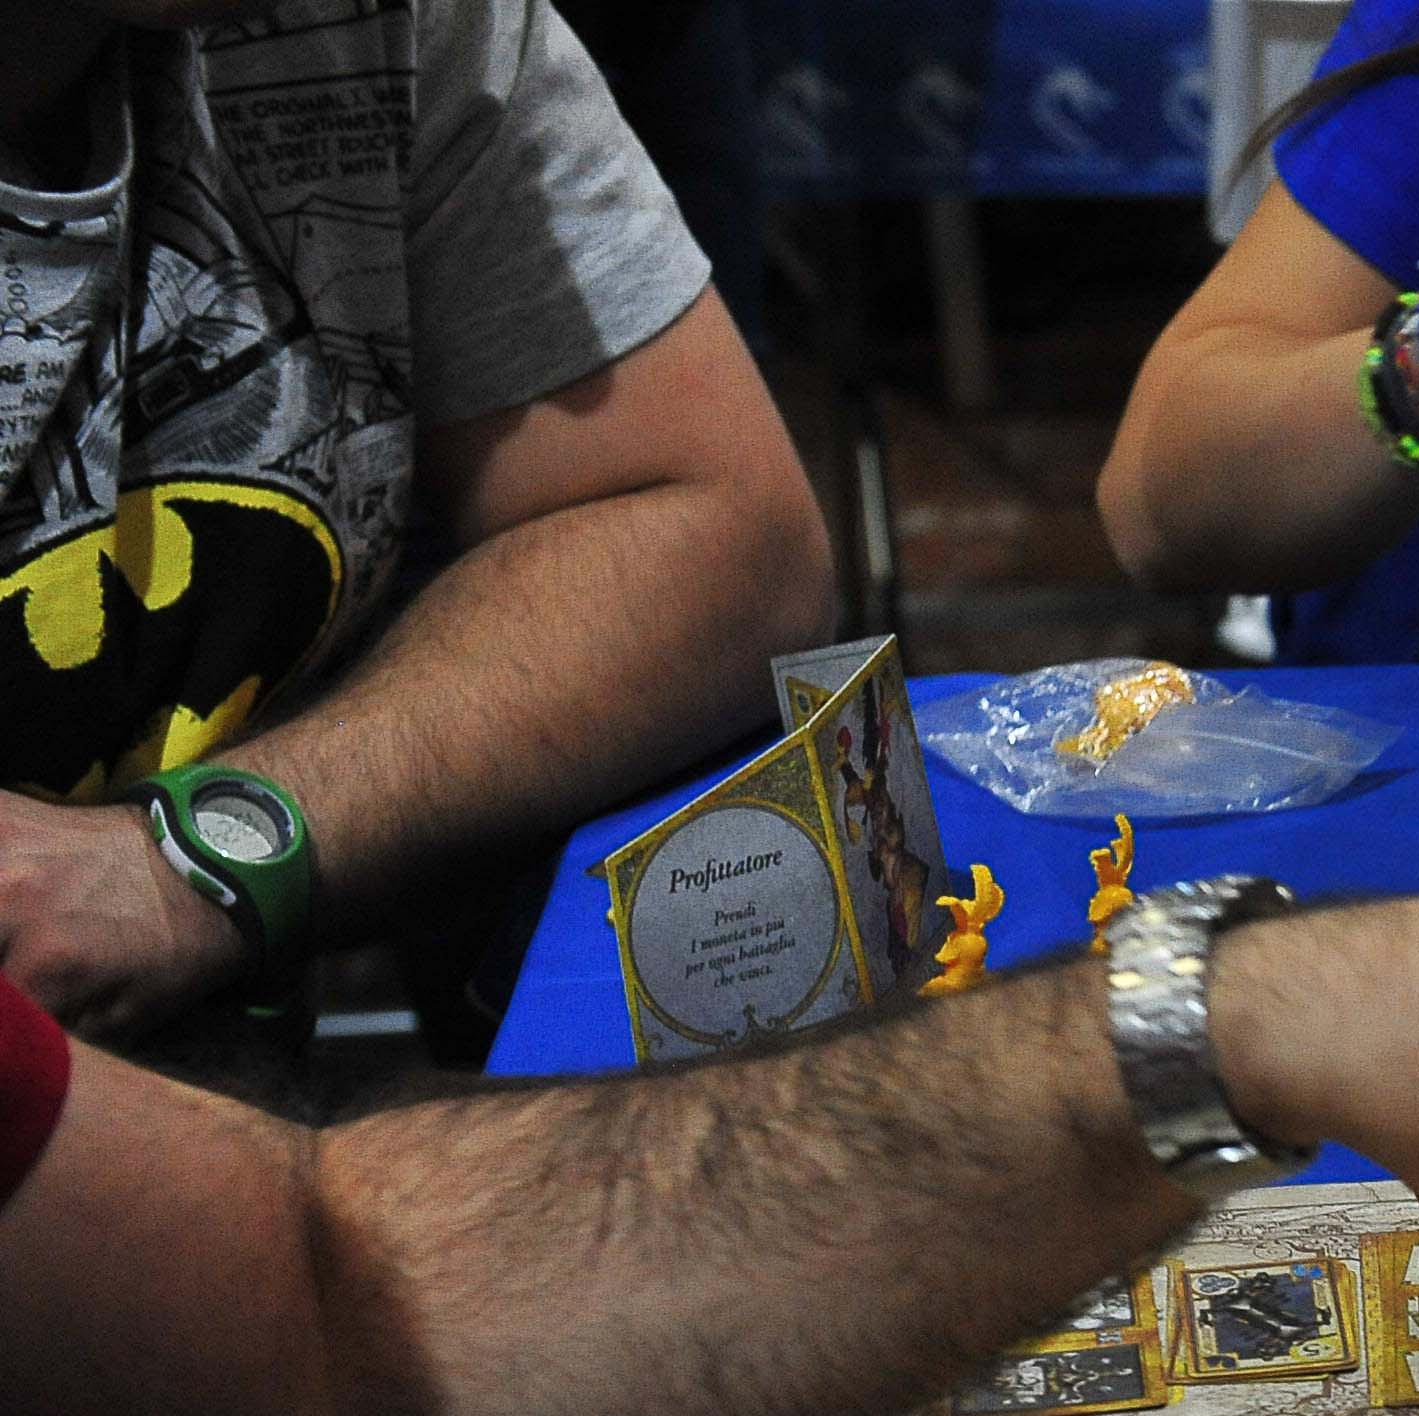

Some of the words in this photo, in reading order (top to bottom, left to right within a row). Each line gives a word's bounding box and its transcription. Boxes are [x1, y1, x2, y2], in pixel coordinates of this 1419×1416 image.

[669, 850, 783, 893] Profittatore
[714, 901, 757, 926] Prendi
[700, 930, 748, 951] moneta
[684, 961, 705, 980] per
[708, 952, 736, 972] ogni
[739, 934, 797, 961] battaglia
[713, 970, 736, 987] che
